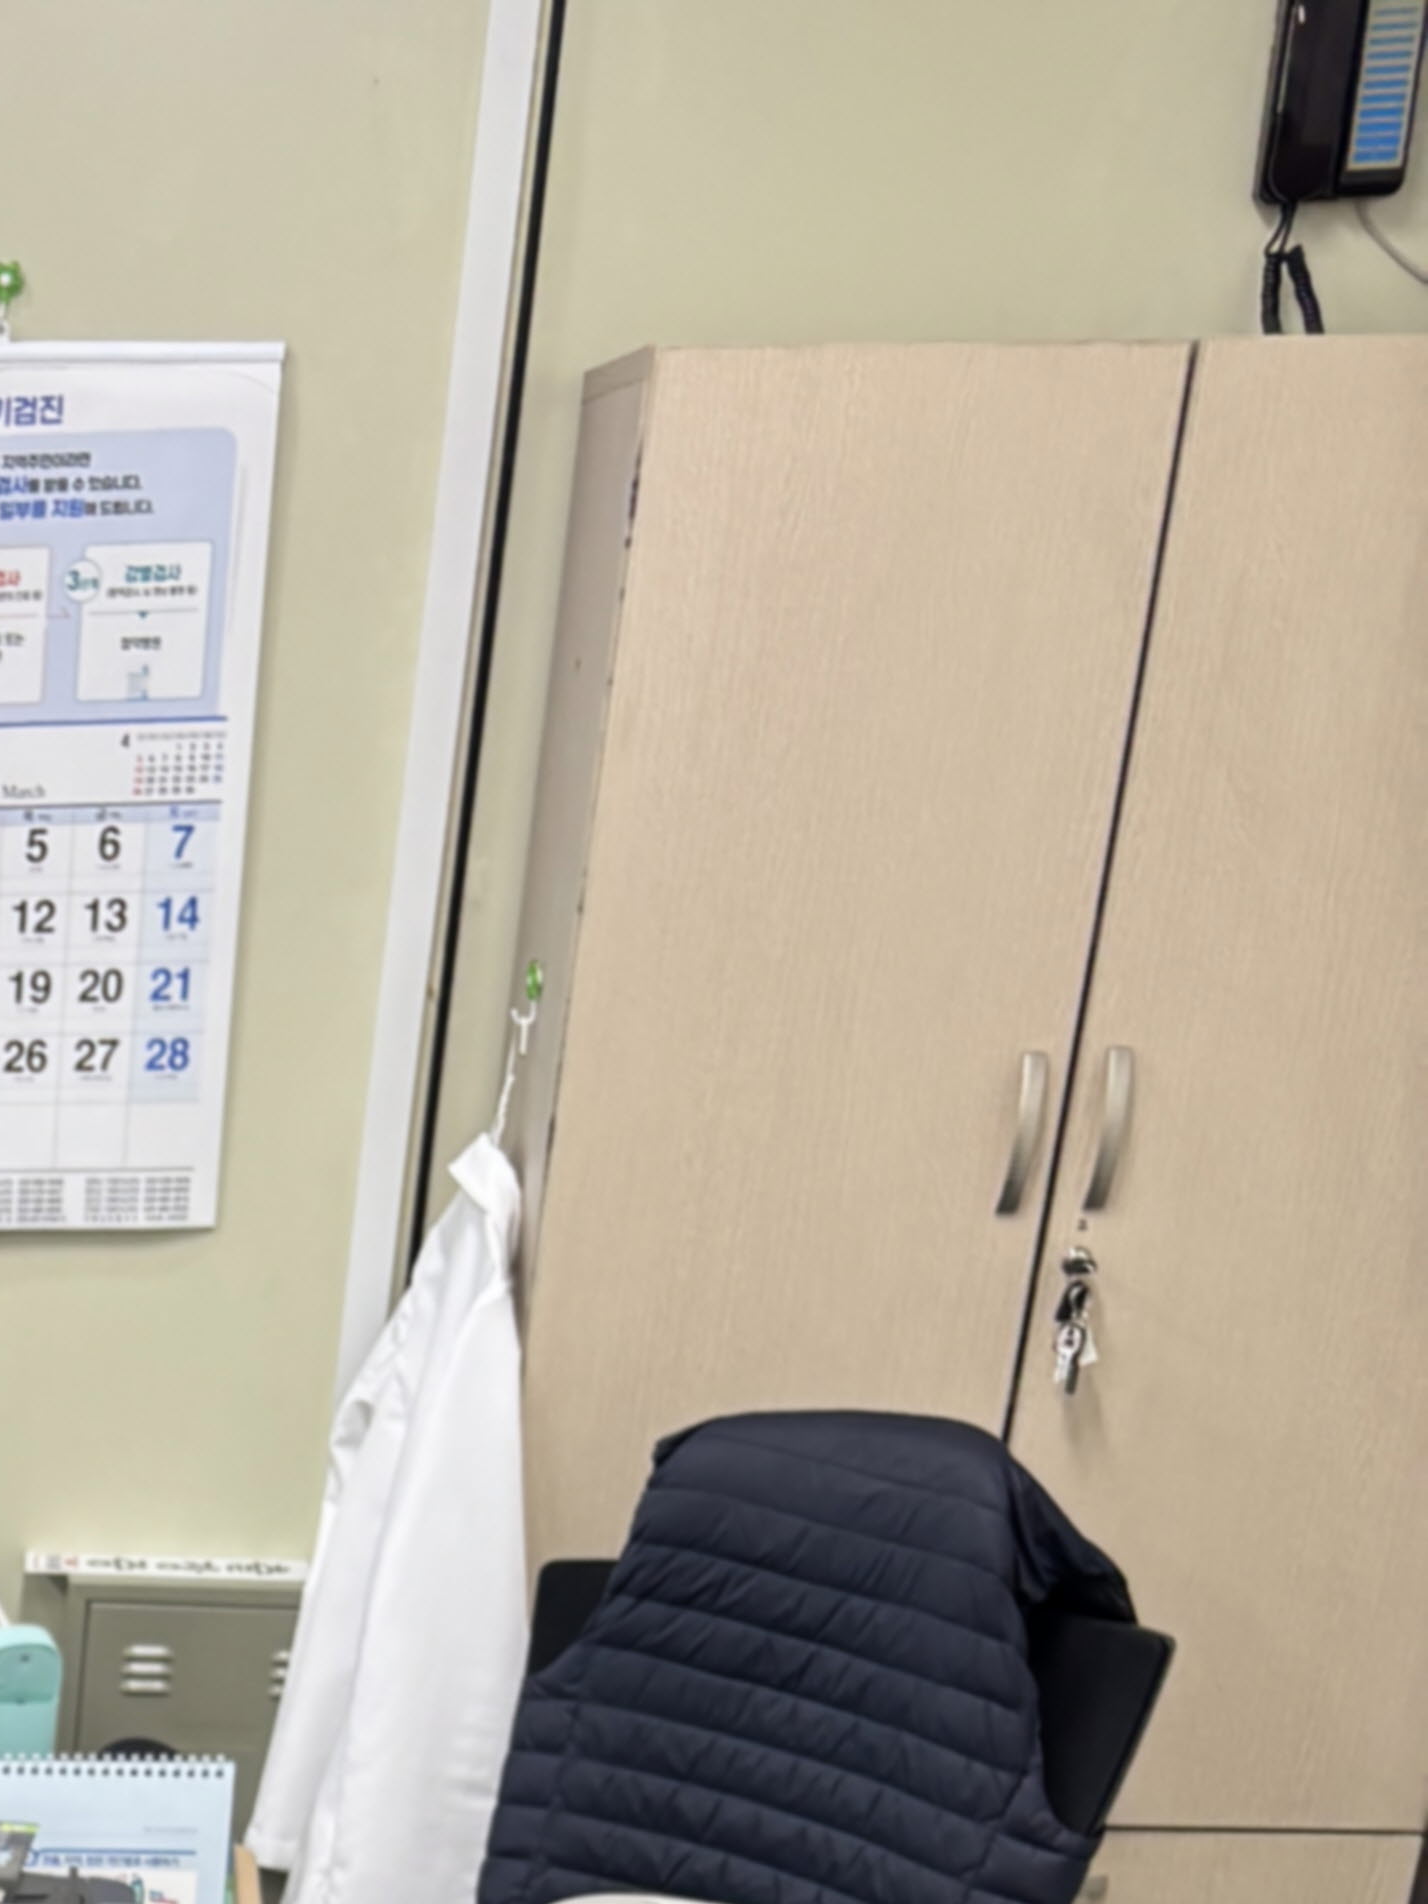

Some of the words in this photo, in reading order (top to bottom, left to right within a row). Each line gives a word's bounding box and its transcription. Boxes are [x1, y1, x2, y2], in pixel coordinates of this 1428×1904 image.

[26, 828, 48, 863] 5
[98, 825, 121, 862] 6
[172, 824, 195, 859] 7
[14, 899, 56, 934] 12
[86, 897, 127, 933] 13
[159, 896, 199, 930] 14
[10, 970, 52, 1004] 19
[79, 968, 124, 1003] 20
[150, 967, 190, 1002] 21
[4, 1039, 47, 1073] 26
[74, 1038, 120, 1072] 27
[145, 1037, 190, 1071] 28
